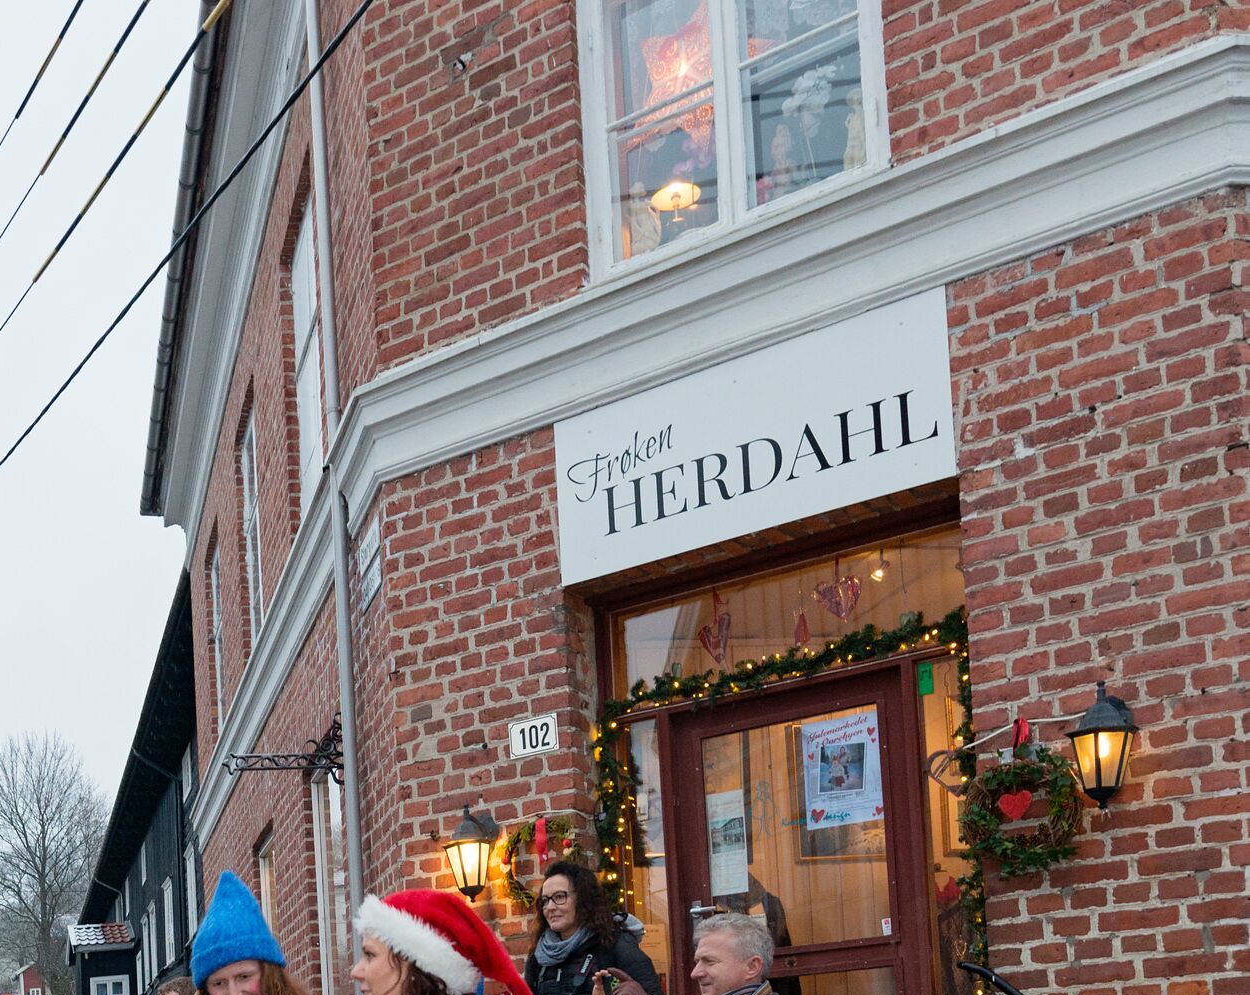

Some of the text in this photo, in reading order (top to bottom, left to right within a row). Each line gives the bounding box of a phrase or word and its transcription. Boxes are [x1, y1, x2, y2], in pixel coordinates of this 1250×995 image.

[567, 423, 673, 503] Frøken
[604, 390, 939, 537] HERDAHL
[519, 722, 550, 750] 102
